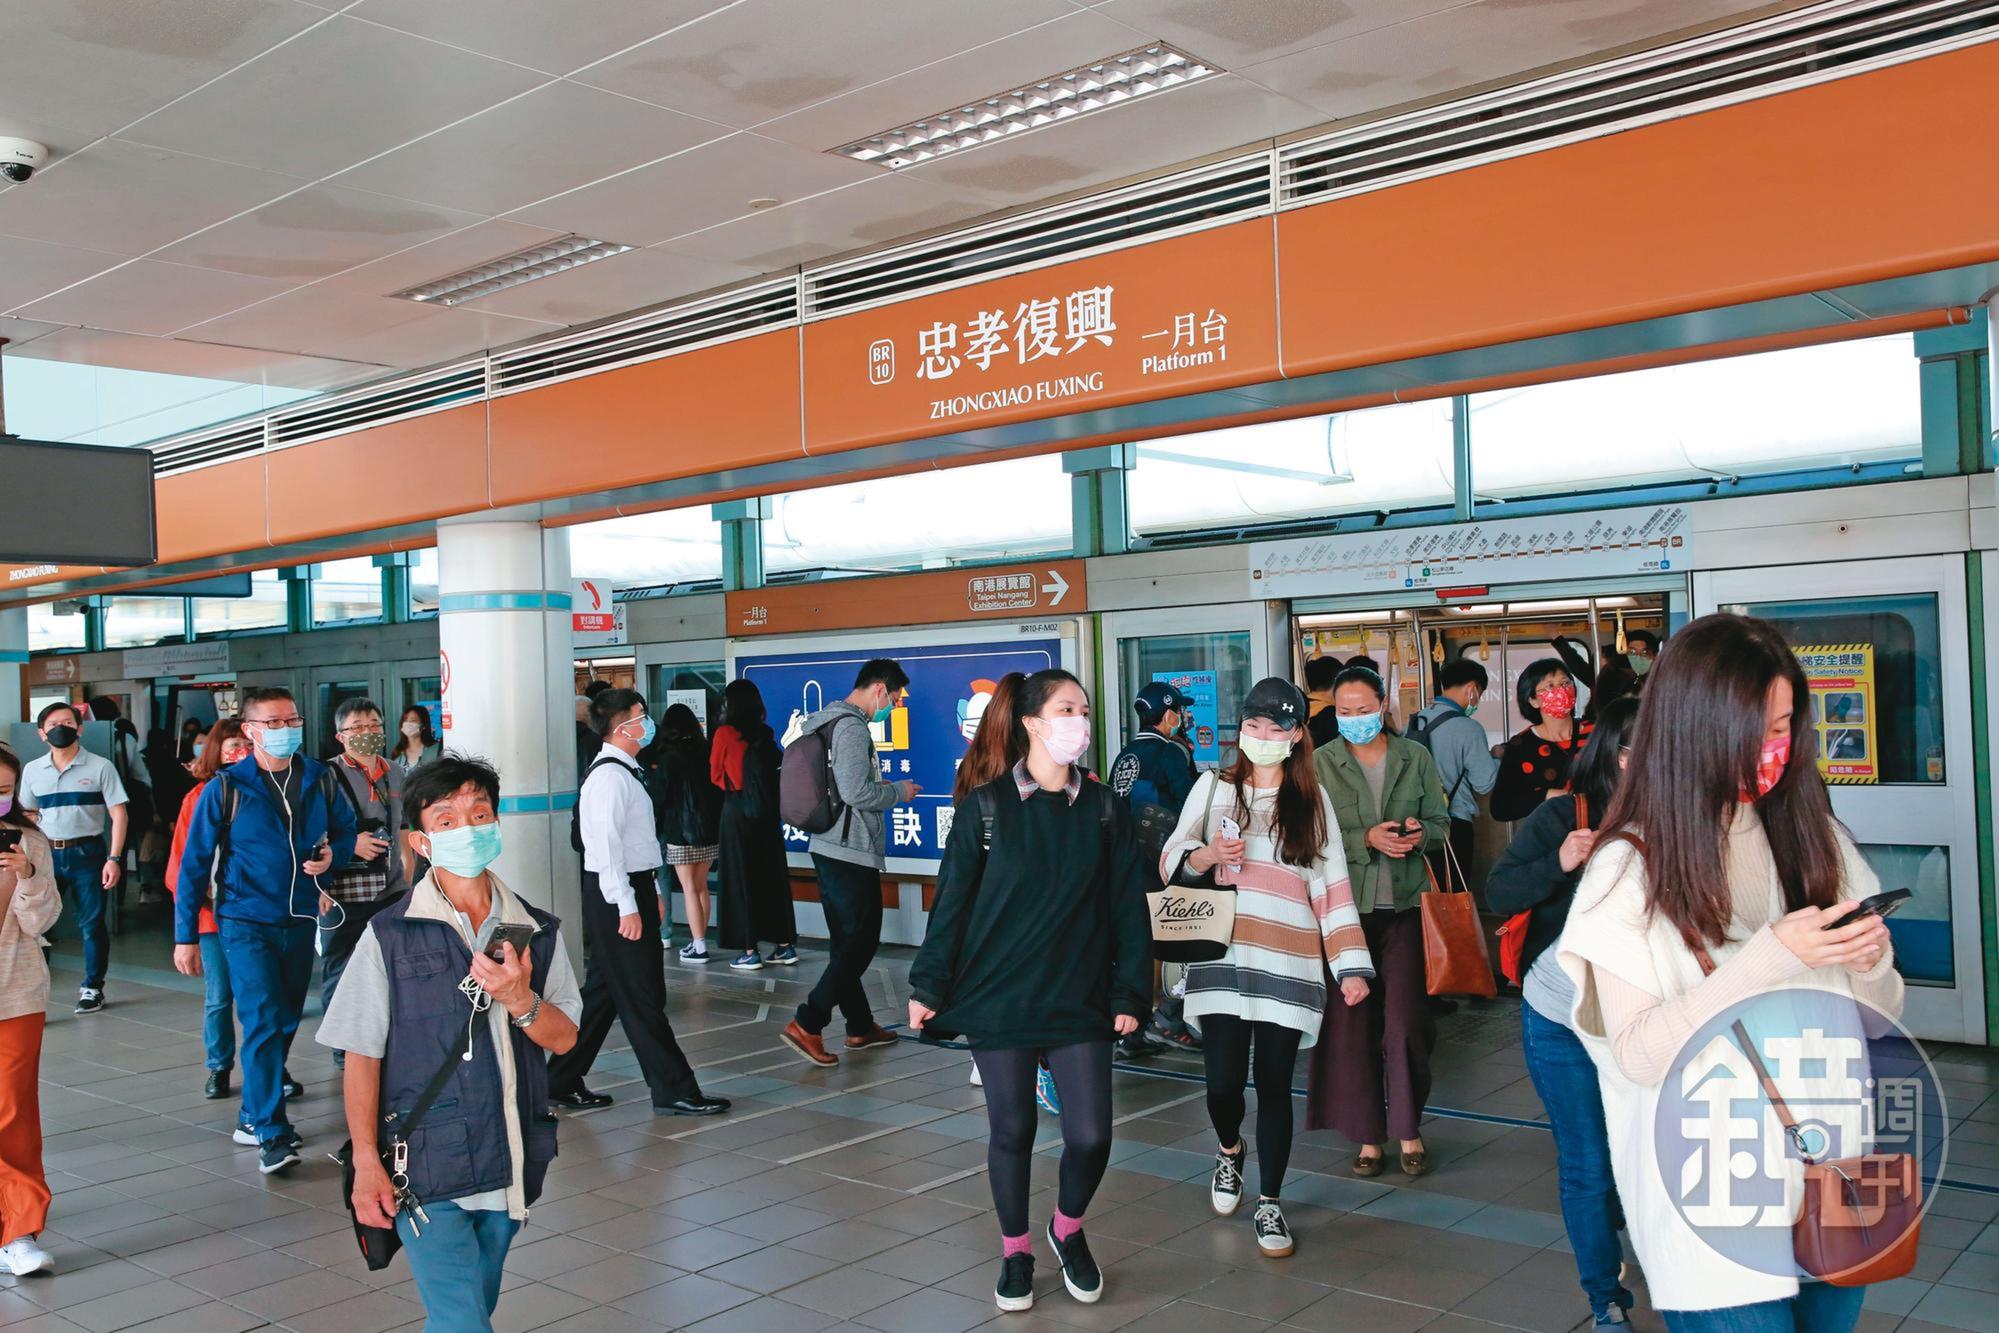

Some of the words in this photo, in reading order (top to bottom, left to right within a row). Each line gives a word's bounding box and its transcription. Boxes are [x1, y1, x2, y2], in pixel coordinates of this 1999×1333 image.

[916, 285, 1117, 381] 忠孝復興
[1141, 308, 1229, 350] 一月台
[873, 345, 890, 361] BR
[1142, 349, 1212, 375] Platform
[1218, 345, 1227, 361] 1
[874, 363, 890, 379] 10
[929, 384, 1033, 419] ZHONGXIAO
[1036, 372, 1104, 401] FUXING
[973, 576, 1031, 593] 南港展覽館
[974, 601, 1007, 609] Exhibition
[1008, 599, 1032, 608] Center
[998, 590, 1029, 600] Nangang
[743, 606, 768, 619] 一月台
[892, 806, 922, 847] 訣
[1155, 897, 1215, 918] Kiehl's
